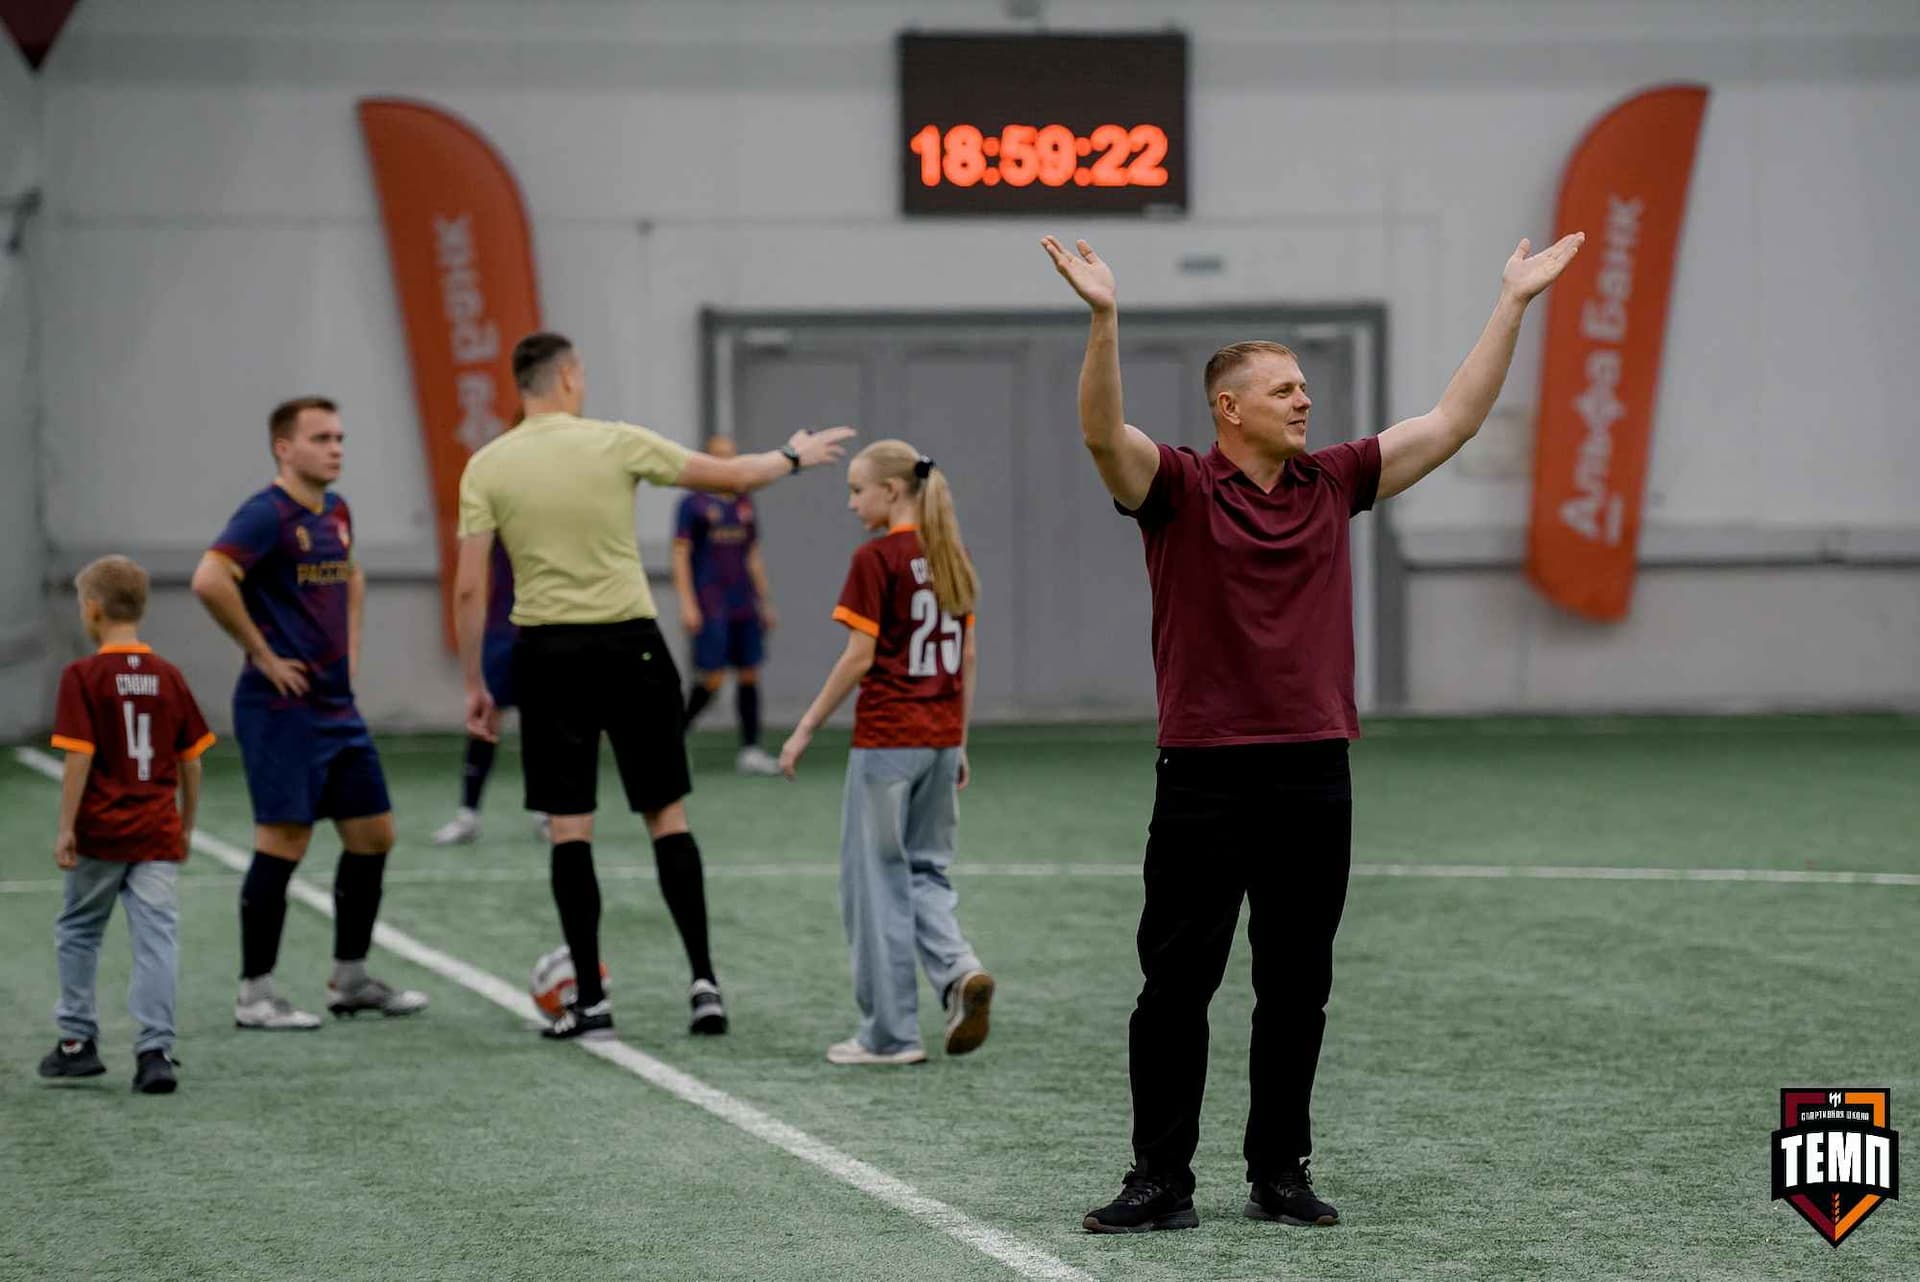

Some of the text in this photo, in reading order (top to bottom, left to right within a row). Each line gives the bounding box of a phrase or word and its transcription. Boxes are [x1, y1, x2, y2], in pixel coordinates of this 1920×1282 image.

[910, 124, 1168, 187] 18:59:22
[1580, 193, 1644, 340] Банк
[909, 589, 962, 676] 25
[122, 701, 154, 781] 4
